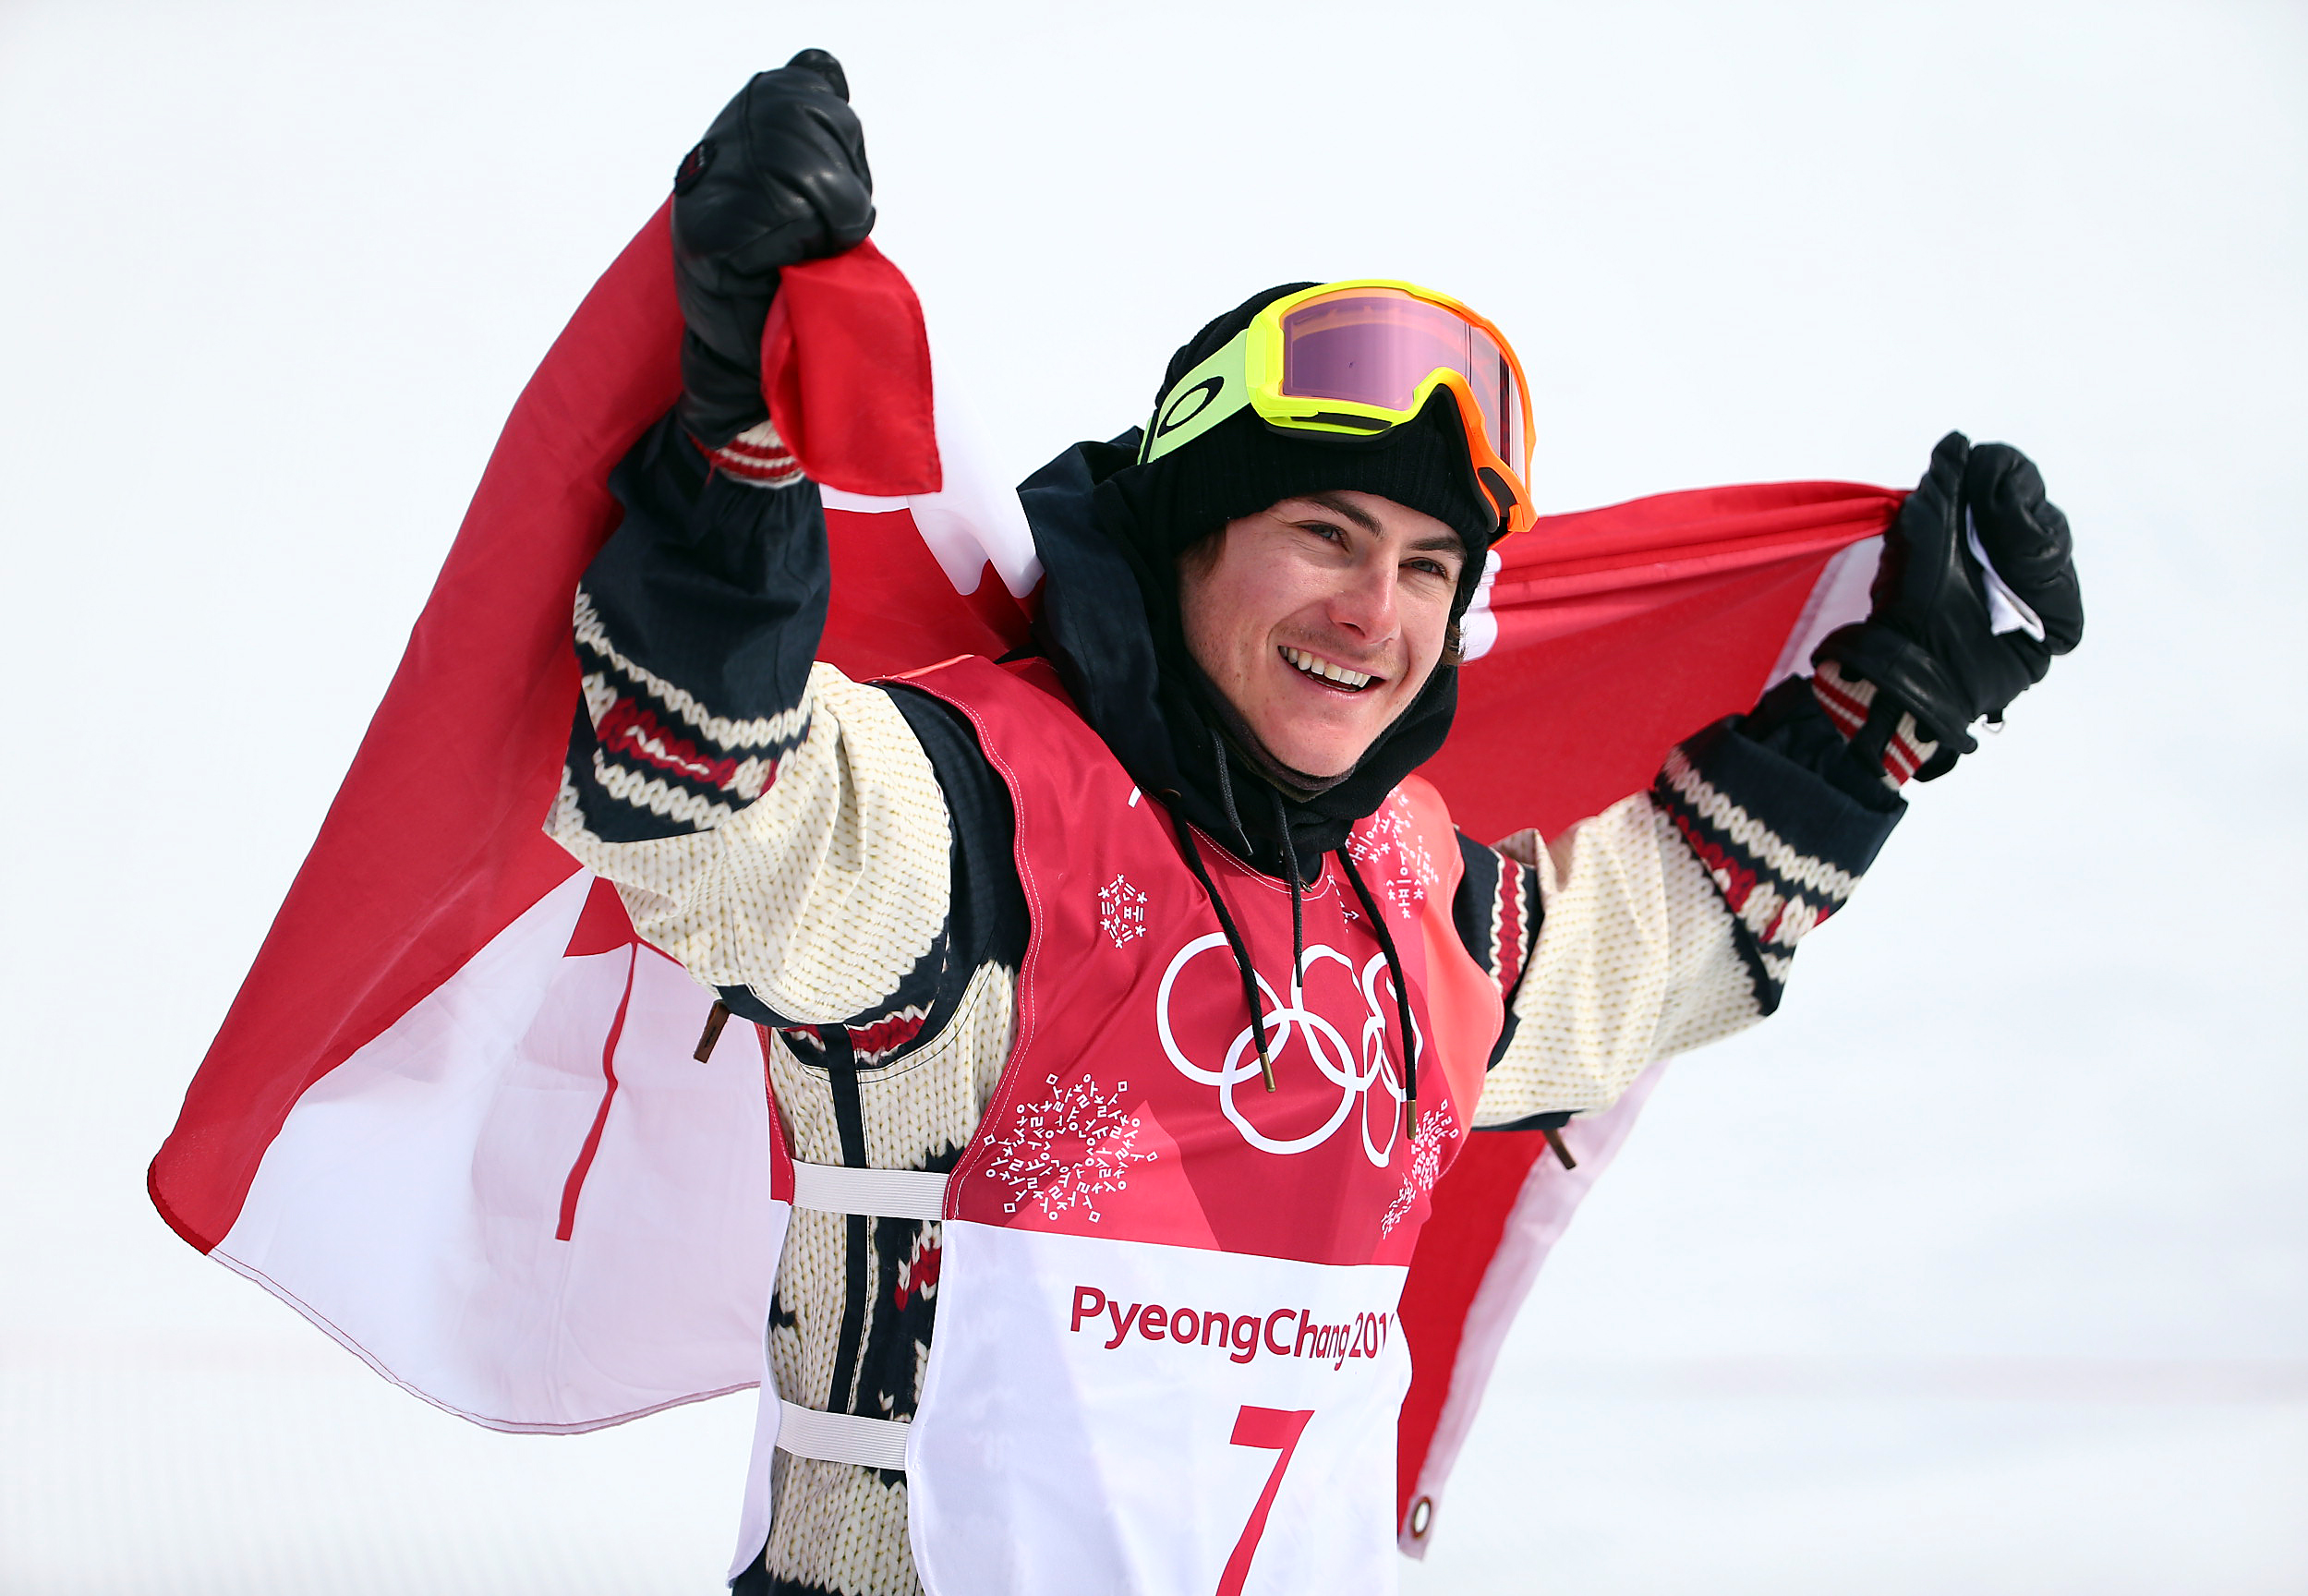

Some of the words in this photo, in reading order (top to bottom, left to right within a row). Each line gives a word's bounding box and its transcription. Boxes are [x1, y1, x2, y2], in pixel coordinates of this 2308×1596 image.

[1070, 1285, 1350, 1372] PyeongChang
[1348, 1312, 1395, 1359] 201
[1215, 1405, 1316, 1596] 7
